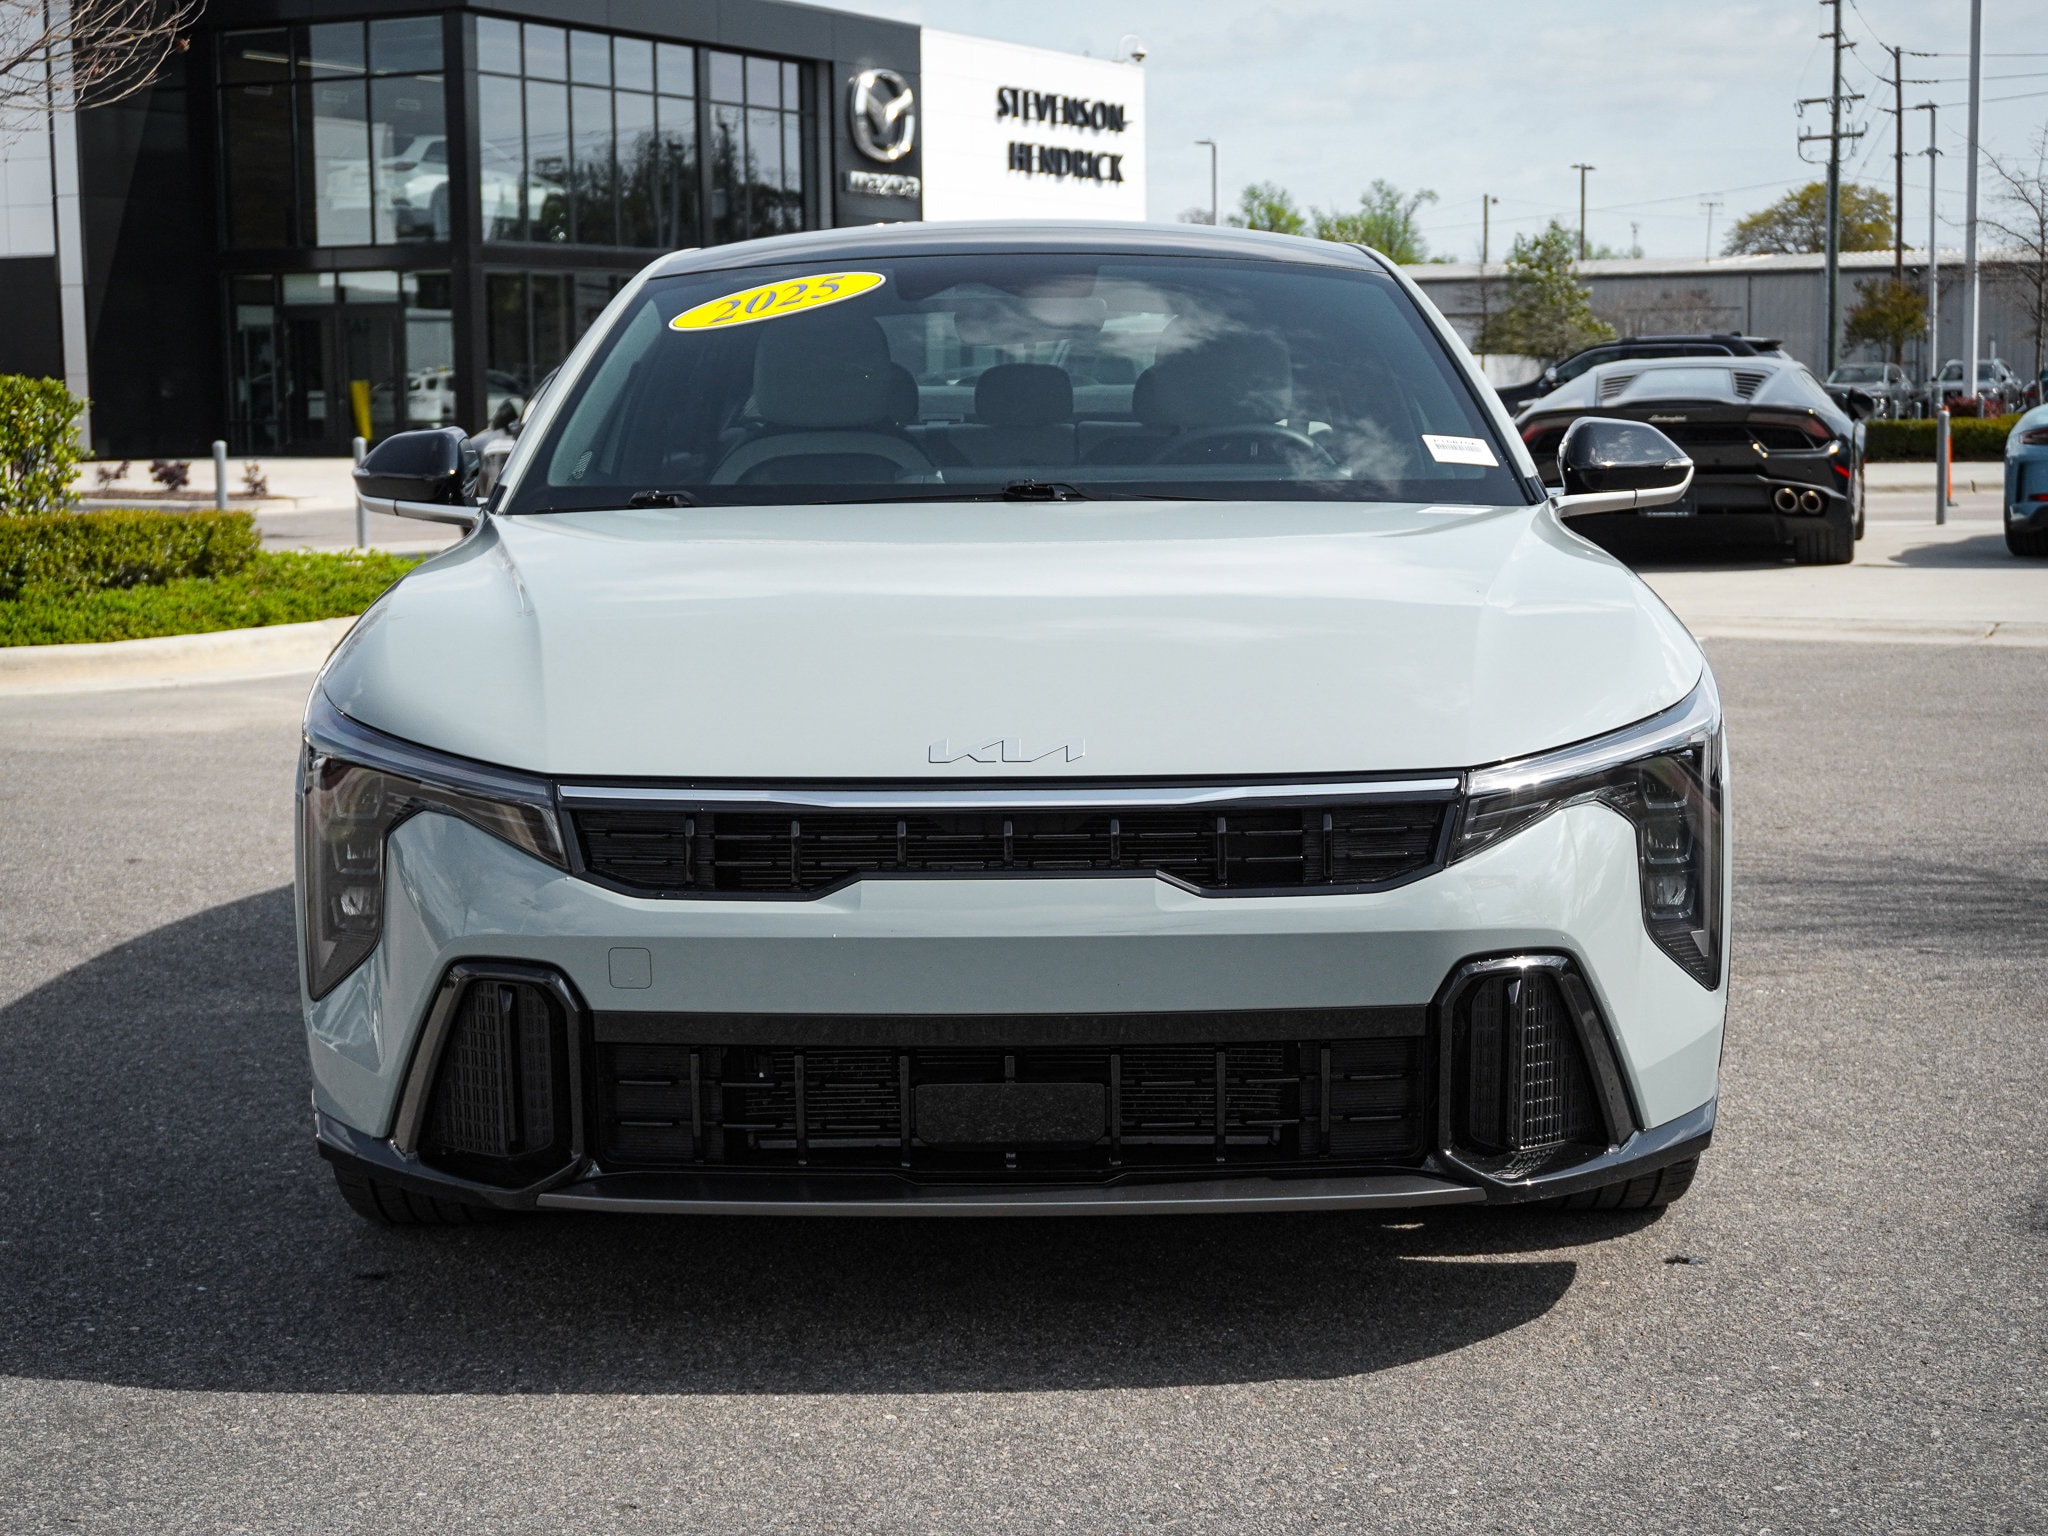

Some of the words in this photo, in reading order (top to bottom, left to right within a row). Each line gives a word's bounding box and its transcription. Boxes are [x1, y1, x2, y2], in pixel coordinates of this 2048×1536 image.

[996, 86, 1125, 132] STEVENSON
[1008, 141, 1124, 182] HENDRICK
[709, 275, 846, 324] 2025
